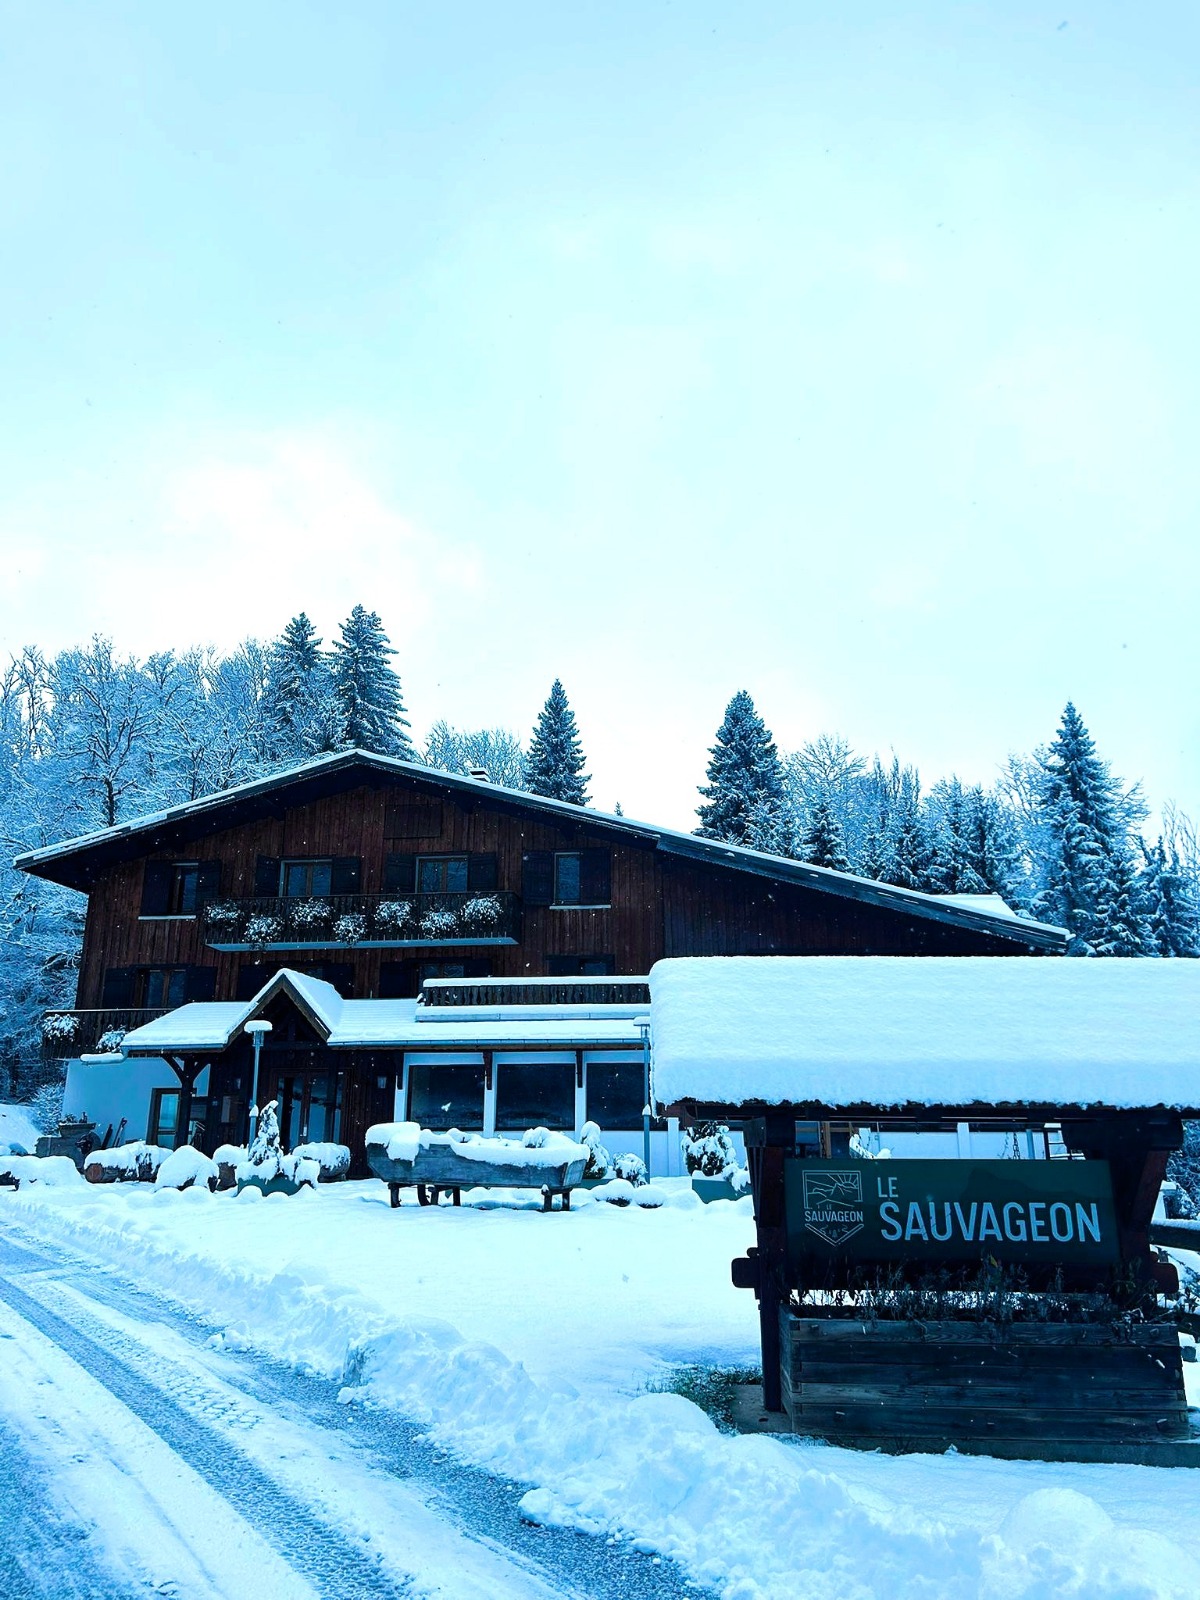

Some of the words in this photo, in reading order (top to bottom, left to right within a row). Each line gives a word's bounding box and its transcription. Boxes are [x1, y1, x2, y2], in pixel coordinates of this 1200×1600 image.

[877, 1176, 898, 1198] LE
[804, 1211, 864, 1222] SAUVAGEON
[880, 1202, 1101, 1242] SAUVAGEON
